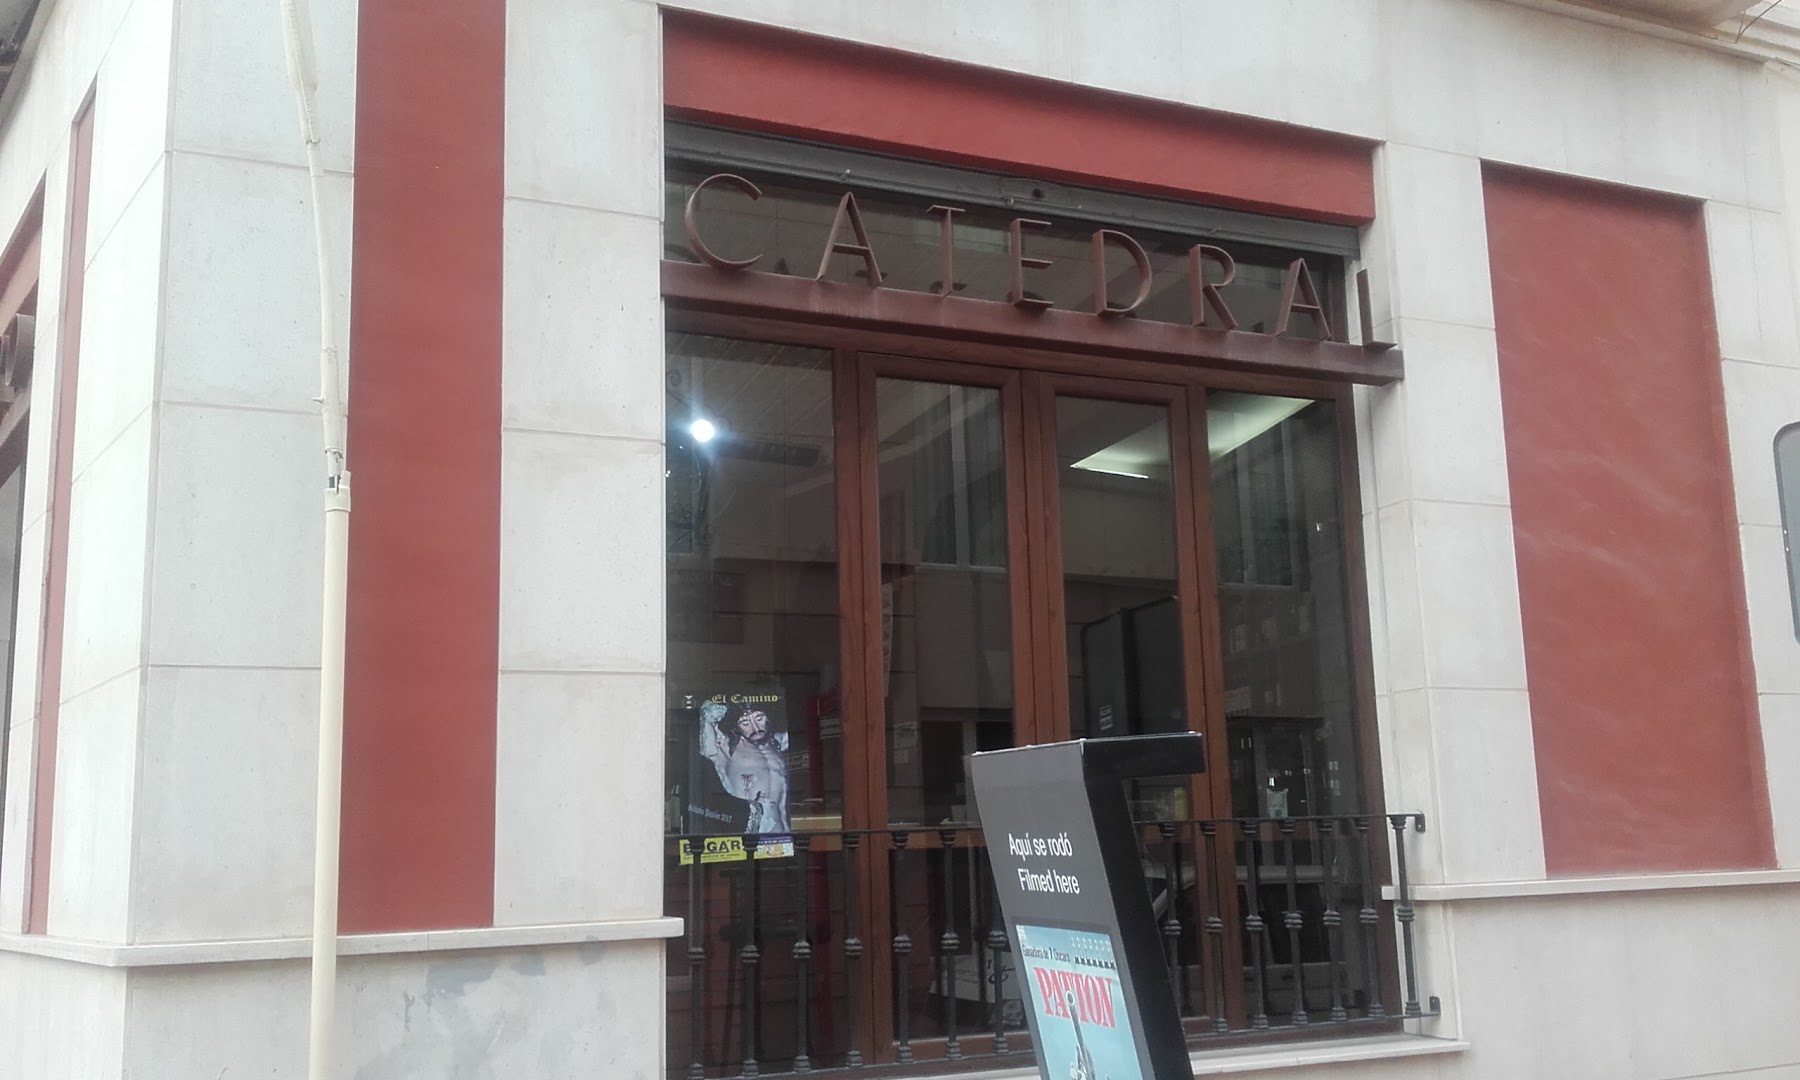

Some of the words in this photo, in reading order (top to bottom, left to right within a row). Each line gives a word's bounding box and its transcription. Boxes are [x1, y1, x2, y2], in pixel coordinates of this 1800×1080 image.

[685, 173, 1397, 349] CATEDRAL
[712, 694, 727, 704] El
[730, 693, 778, 704] Camino
[1008, 832, 1033, 861] Aquí
[1033, 838, 1047, 856] se
[1047, 832, 1073, 857] rodó
[1017, 868, 1055, 892] Filmed
[1053, 869, 1080, 894] here
[1033, 967, 1115, 1029] PATTON
